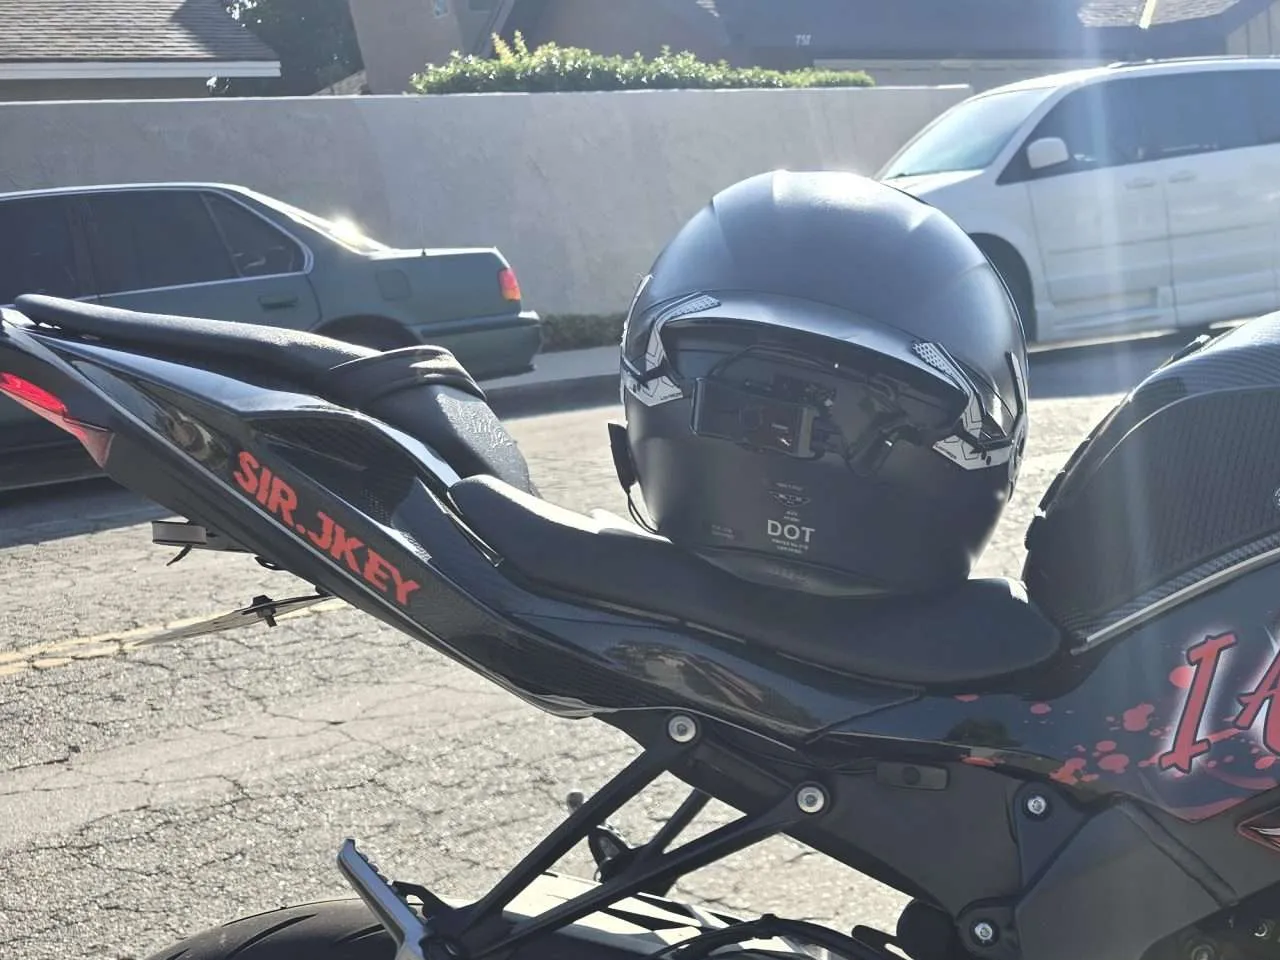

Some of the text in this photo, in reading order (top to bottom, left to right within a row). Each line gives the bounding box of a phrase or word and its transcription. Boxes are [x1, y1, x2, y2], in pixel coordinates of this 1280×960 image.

[233, 450, 421, 606] SIR.JKEY
[767, 519, 816, 543] DOT
[1158, 631, 1237, 774] I
